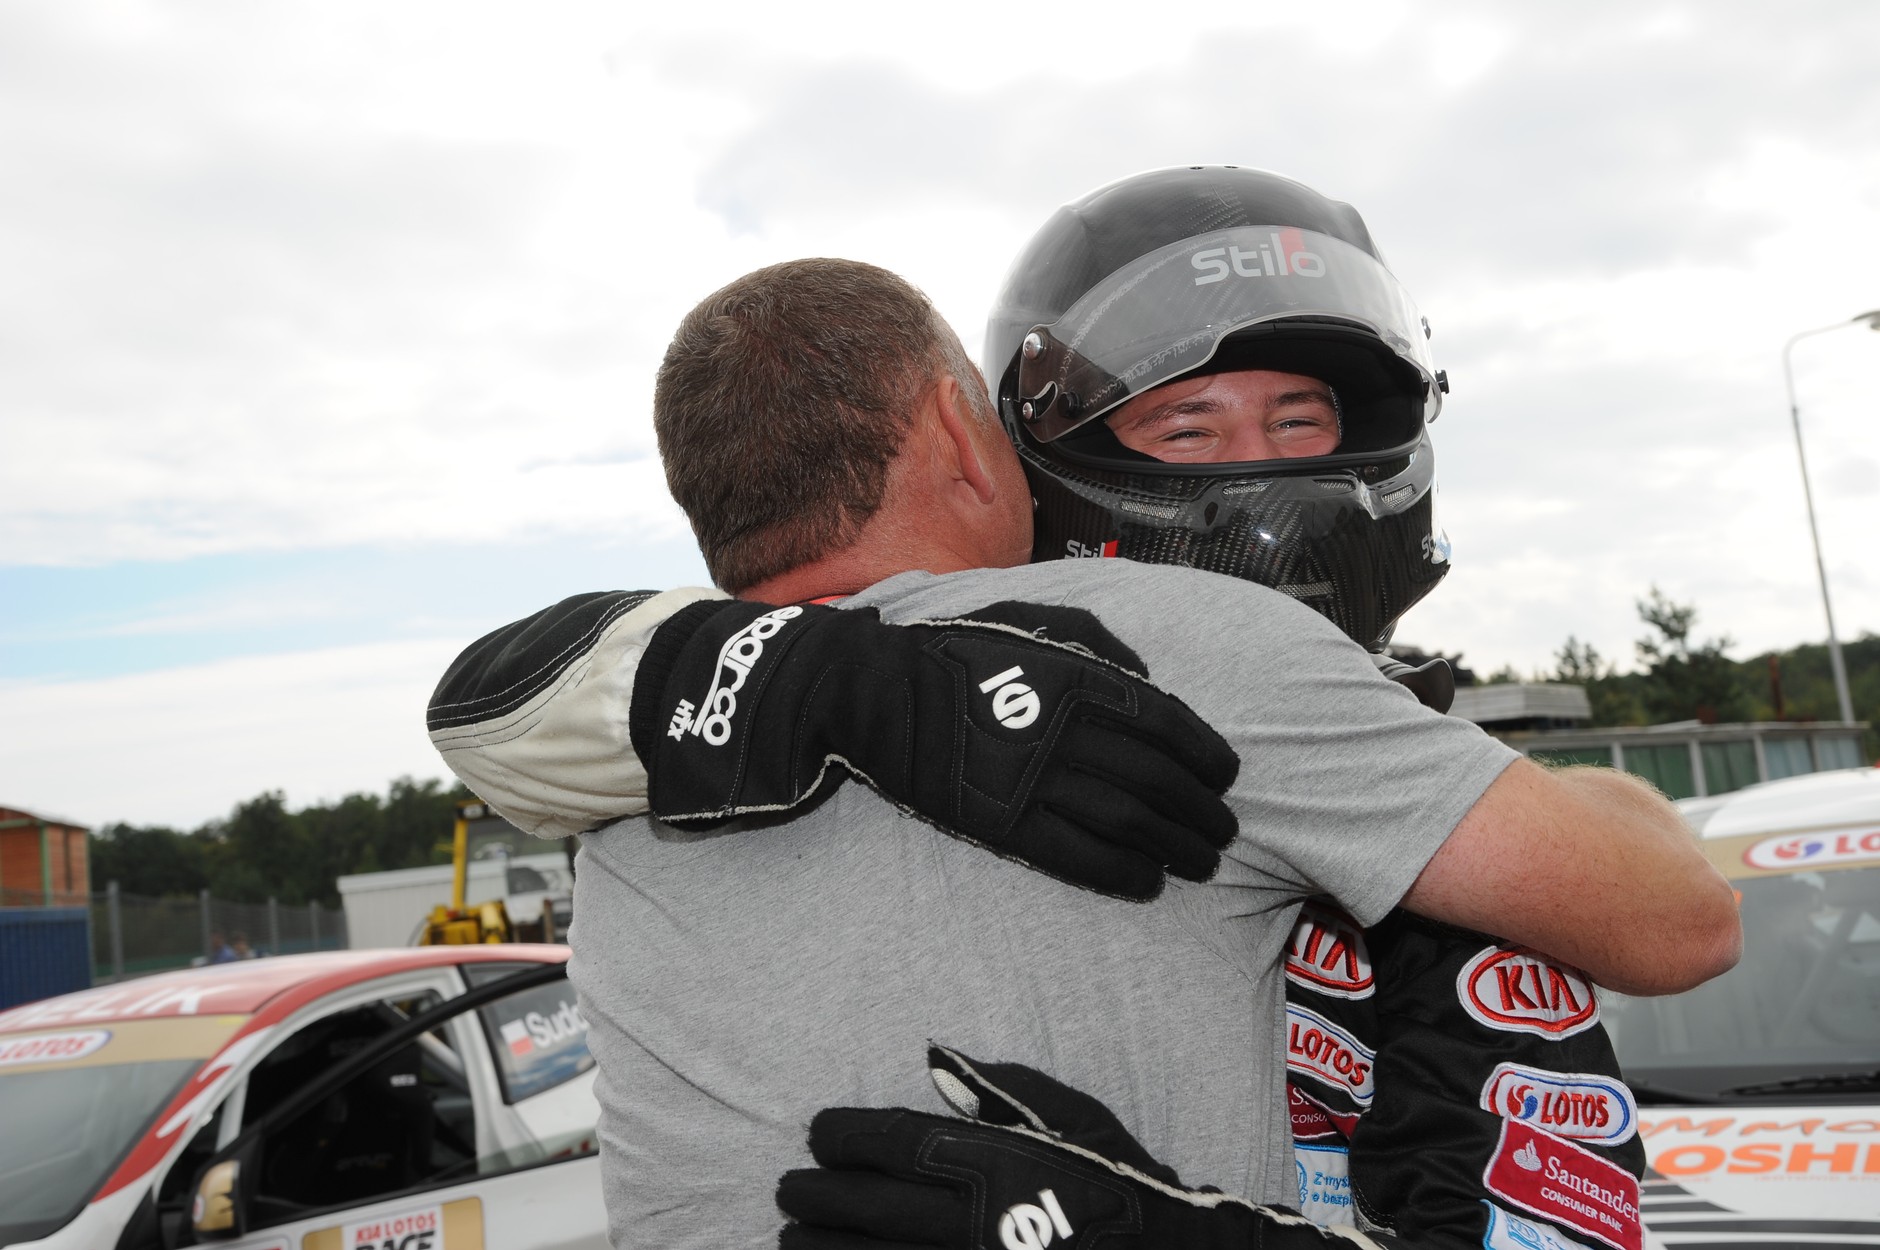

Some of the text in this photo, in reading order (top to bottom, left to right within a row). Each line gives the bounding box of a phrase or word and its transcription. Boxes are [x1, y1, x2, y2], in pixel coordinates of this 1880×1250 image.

[1191, 232, 1326, 286] Stilo
[695, 605, 804, 746] sparco
[1493, 964, 1582, 1013] KIA
[1289, 1022, 1371, 1087] LOTOS
[1291, 1112, 1329, 1124] CONSU
[1539, 1090, 1610, 1128] LOTOS
[1313, 1171, 1323, 1186] Z
[1544, 1155, 1639, 1223] Santander
[384, 1210, 437, 1238] LOTOS
[1540, 1186, 1624, 1235] CONSUMER BANK
